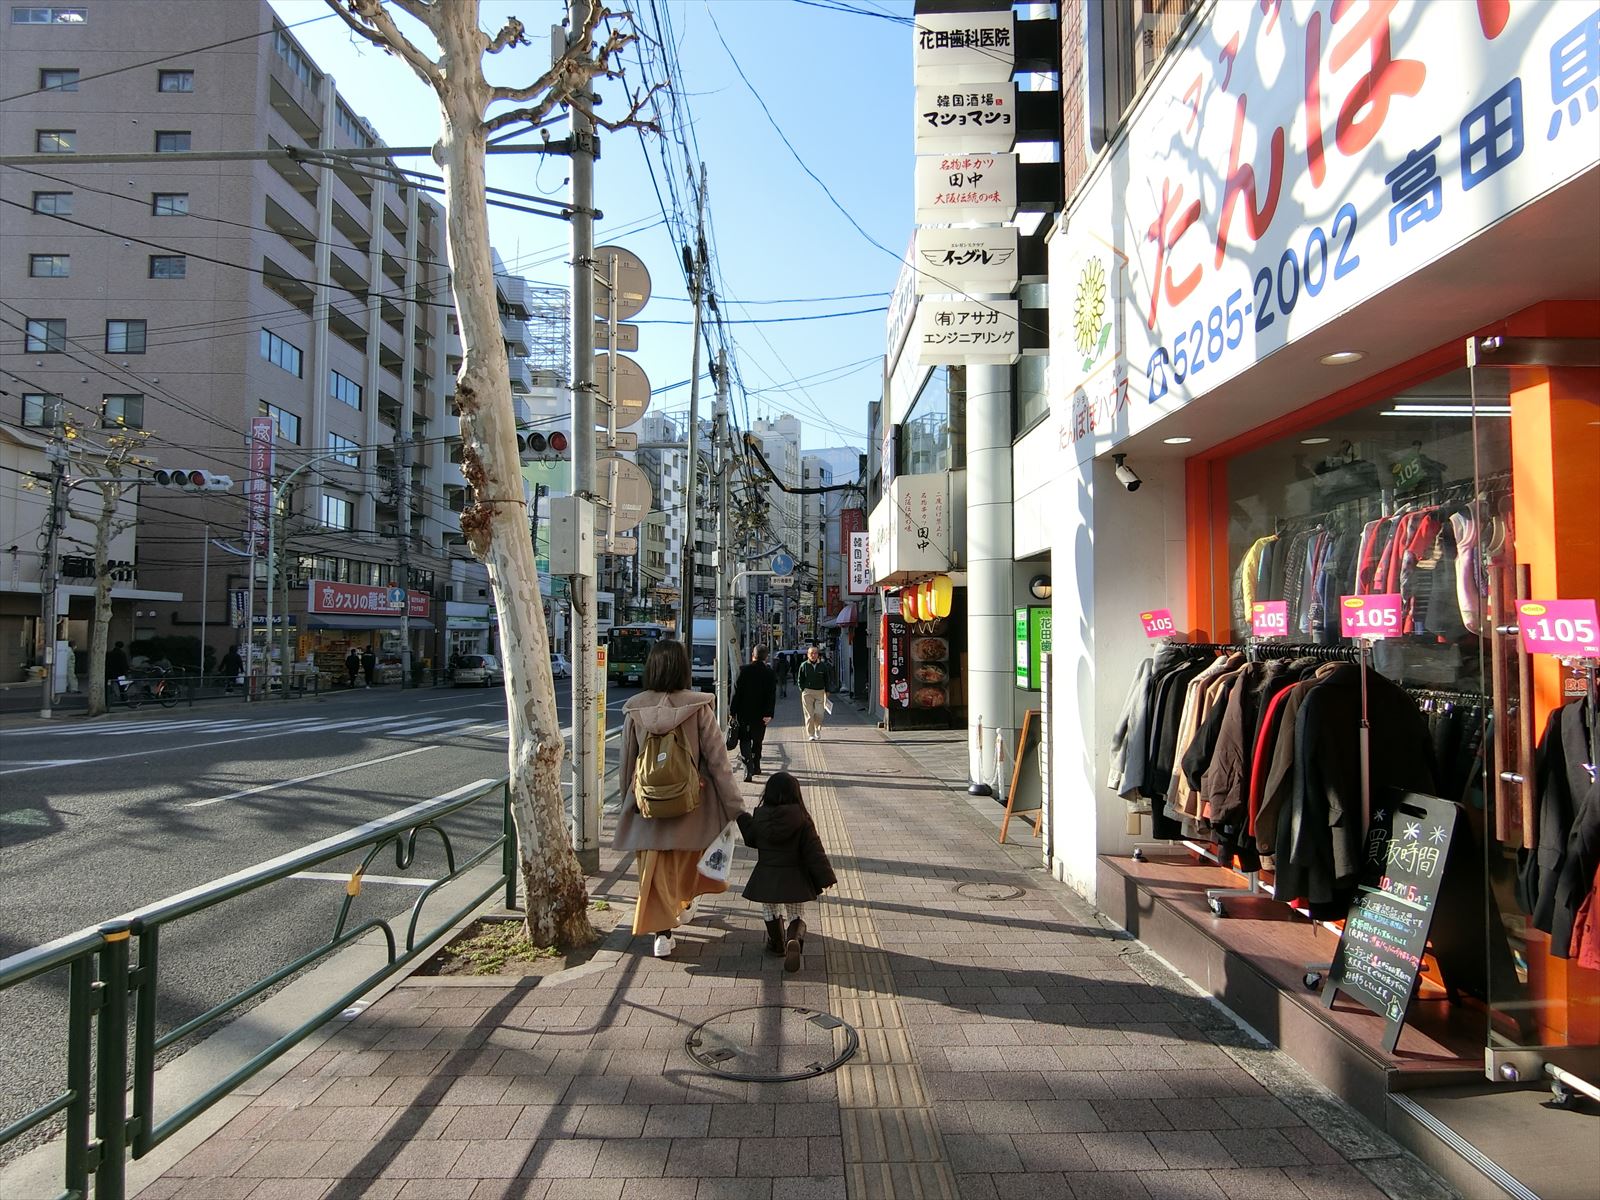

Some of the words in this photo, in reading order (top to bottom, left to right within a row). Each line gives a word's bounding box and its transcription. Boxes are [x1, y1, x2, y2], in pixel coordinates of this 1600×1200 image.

[920, 28, 1011, 50] 花田歯科医院
[937, 93, 994, 107] 韓国酒場
[940, 158, 994, 171] 名物串カツ
[949, 172, 984, 188] 田中
[934, 190, 1002, 205] 大阪伝統の味
[942, 249, 994, 265] イーグル
[1173, 203, 1361, 385] 5285-2002
[923, 331, 1015, 344] エンジニアリング
[917, 526, 929, 554] 田中
[853, 537, 863, 585] 韓国酒場
[1346, 608, 1397, 627] ¥105
[1527, 618, 1595, 643] ¥105
[1366, 828, 1440, 878] 買取時間
